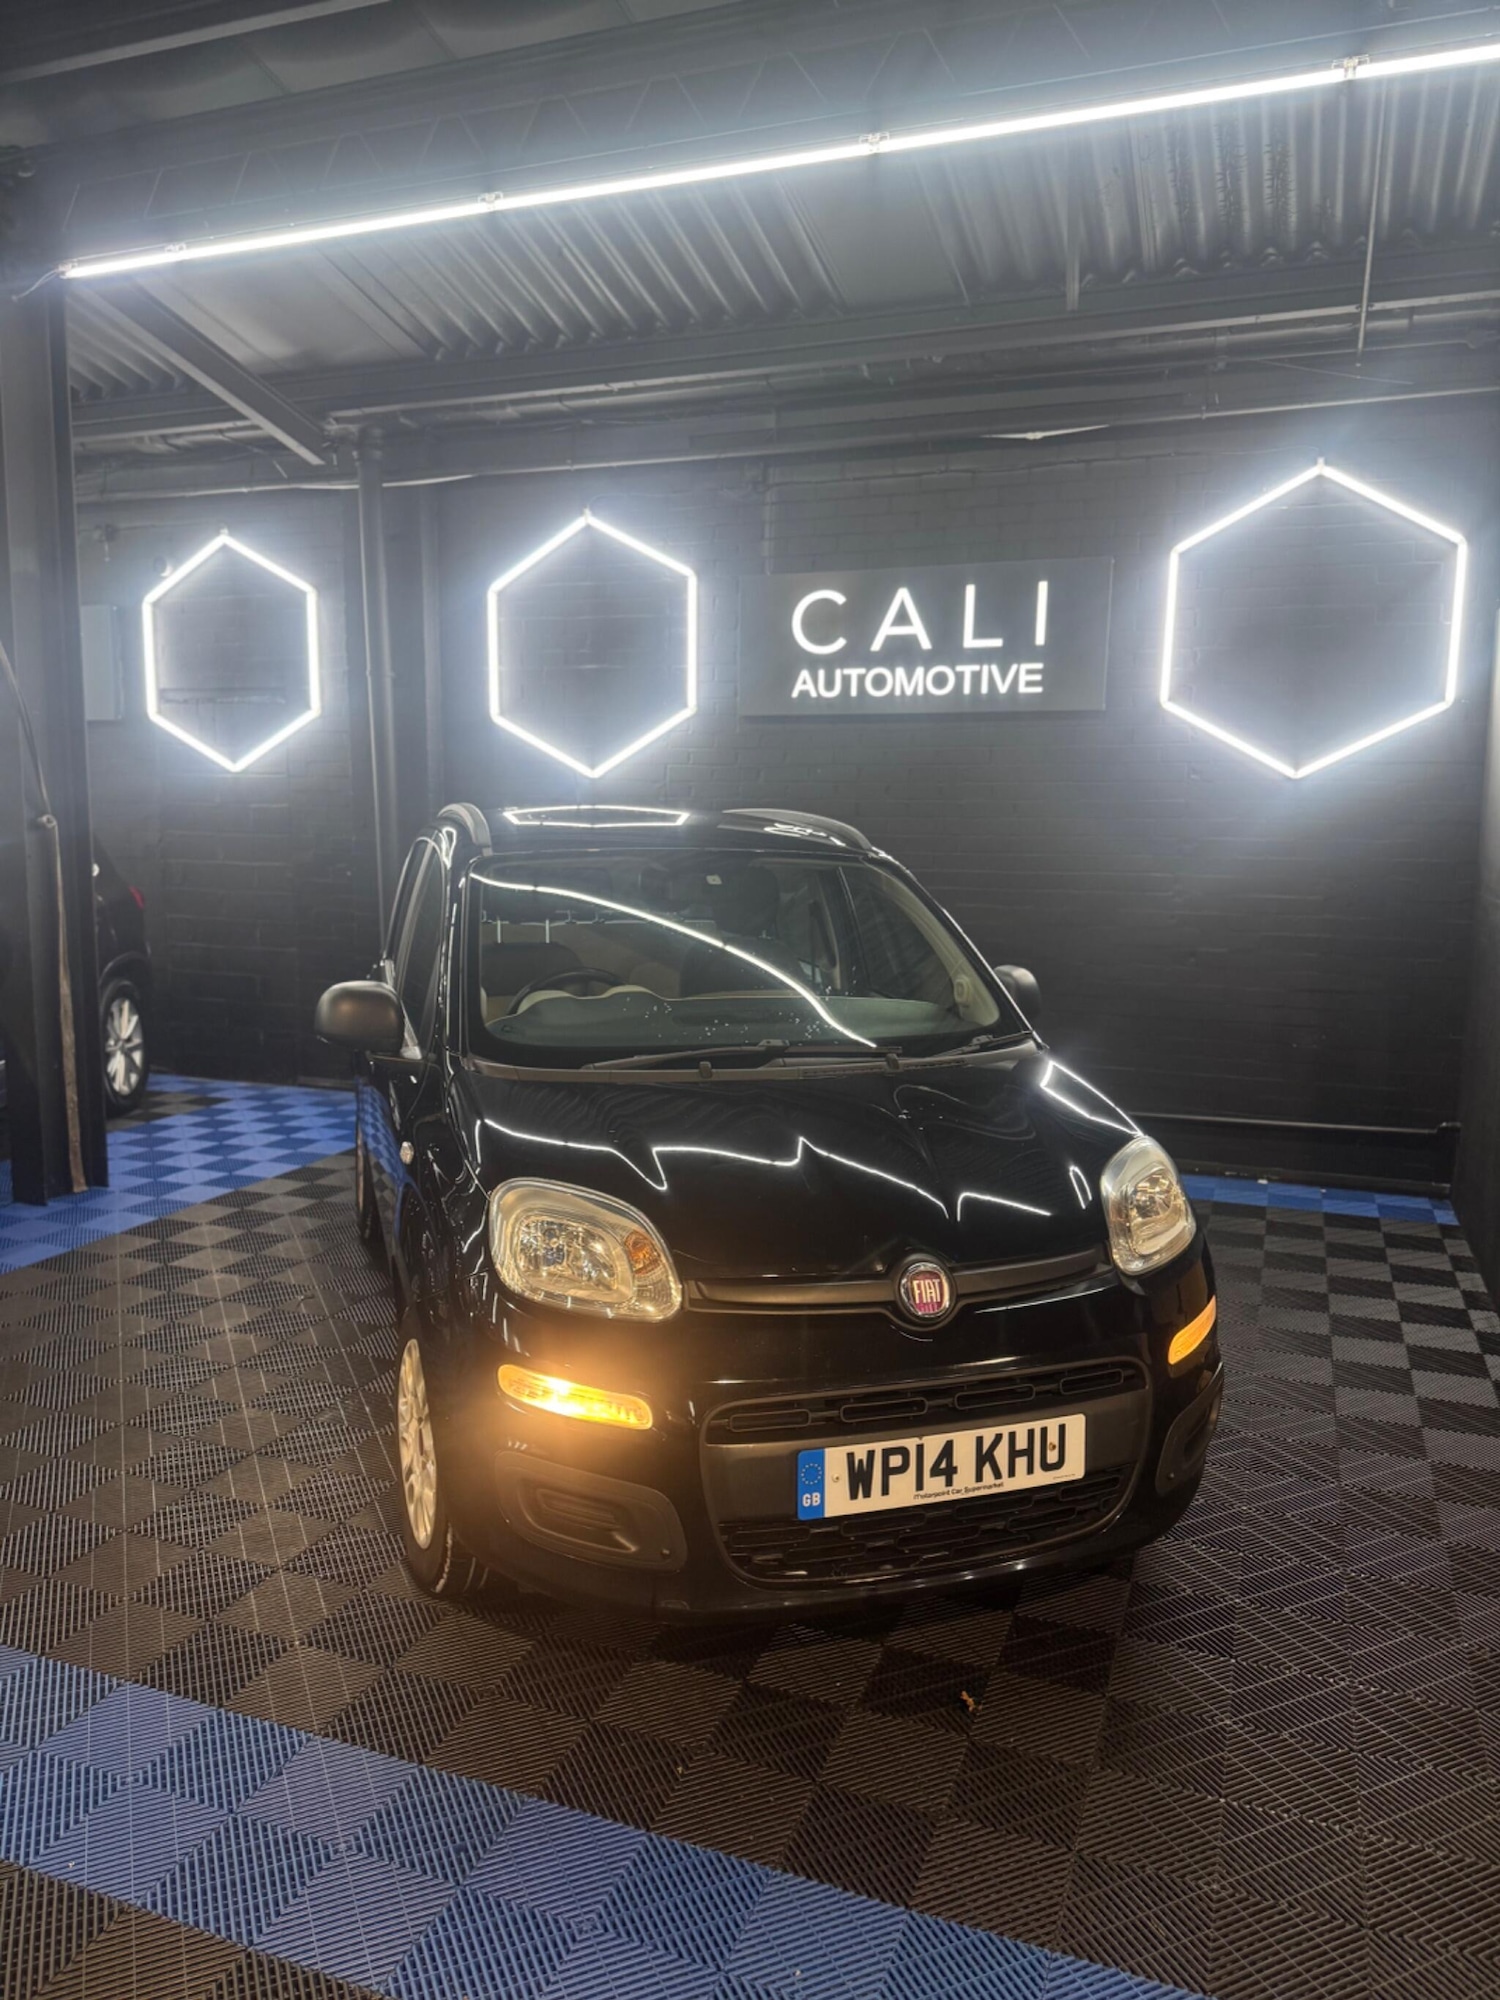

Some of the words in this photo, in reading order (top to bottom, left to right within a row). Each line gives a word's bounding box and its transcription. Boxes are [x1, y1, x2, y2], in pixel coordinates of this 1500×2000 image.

[791, 580, 1048, 655] CALI
[791, 662, 1045, 698] AUTOMOTIVE
[912, 1279, 941, 1304] FIAT
[846, 1439, 958, 1501] WP14
[975, 1423, 1066, 1483] KHU
[802, 1492, 821, 1507] GB
[951, 1487, 962, 1495] Car
[963, 1482, 1004, 1494] Supermarket
